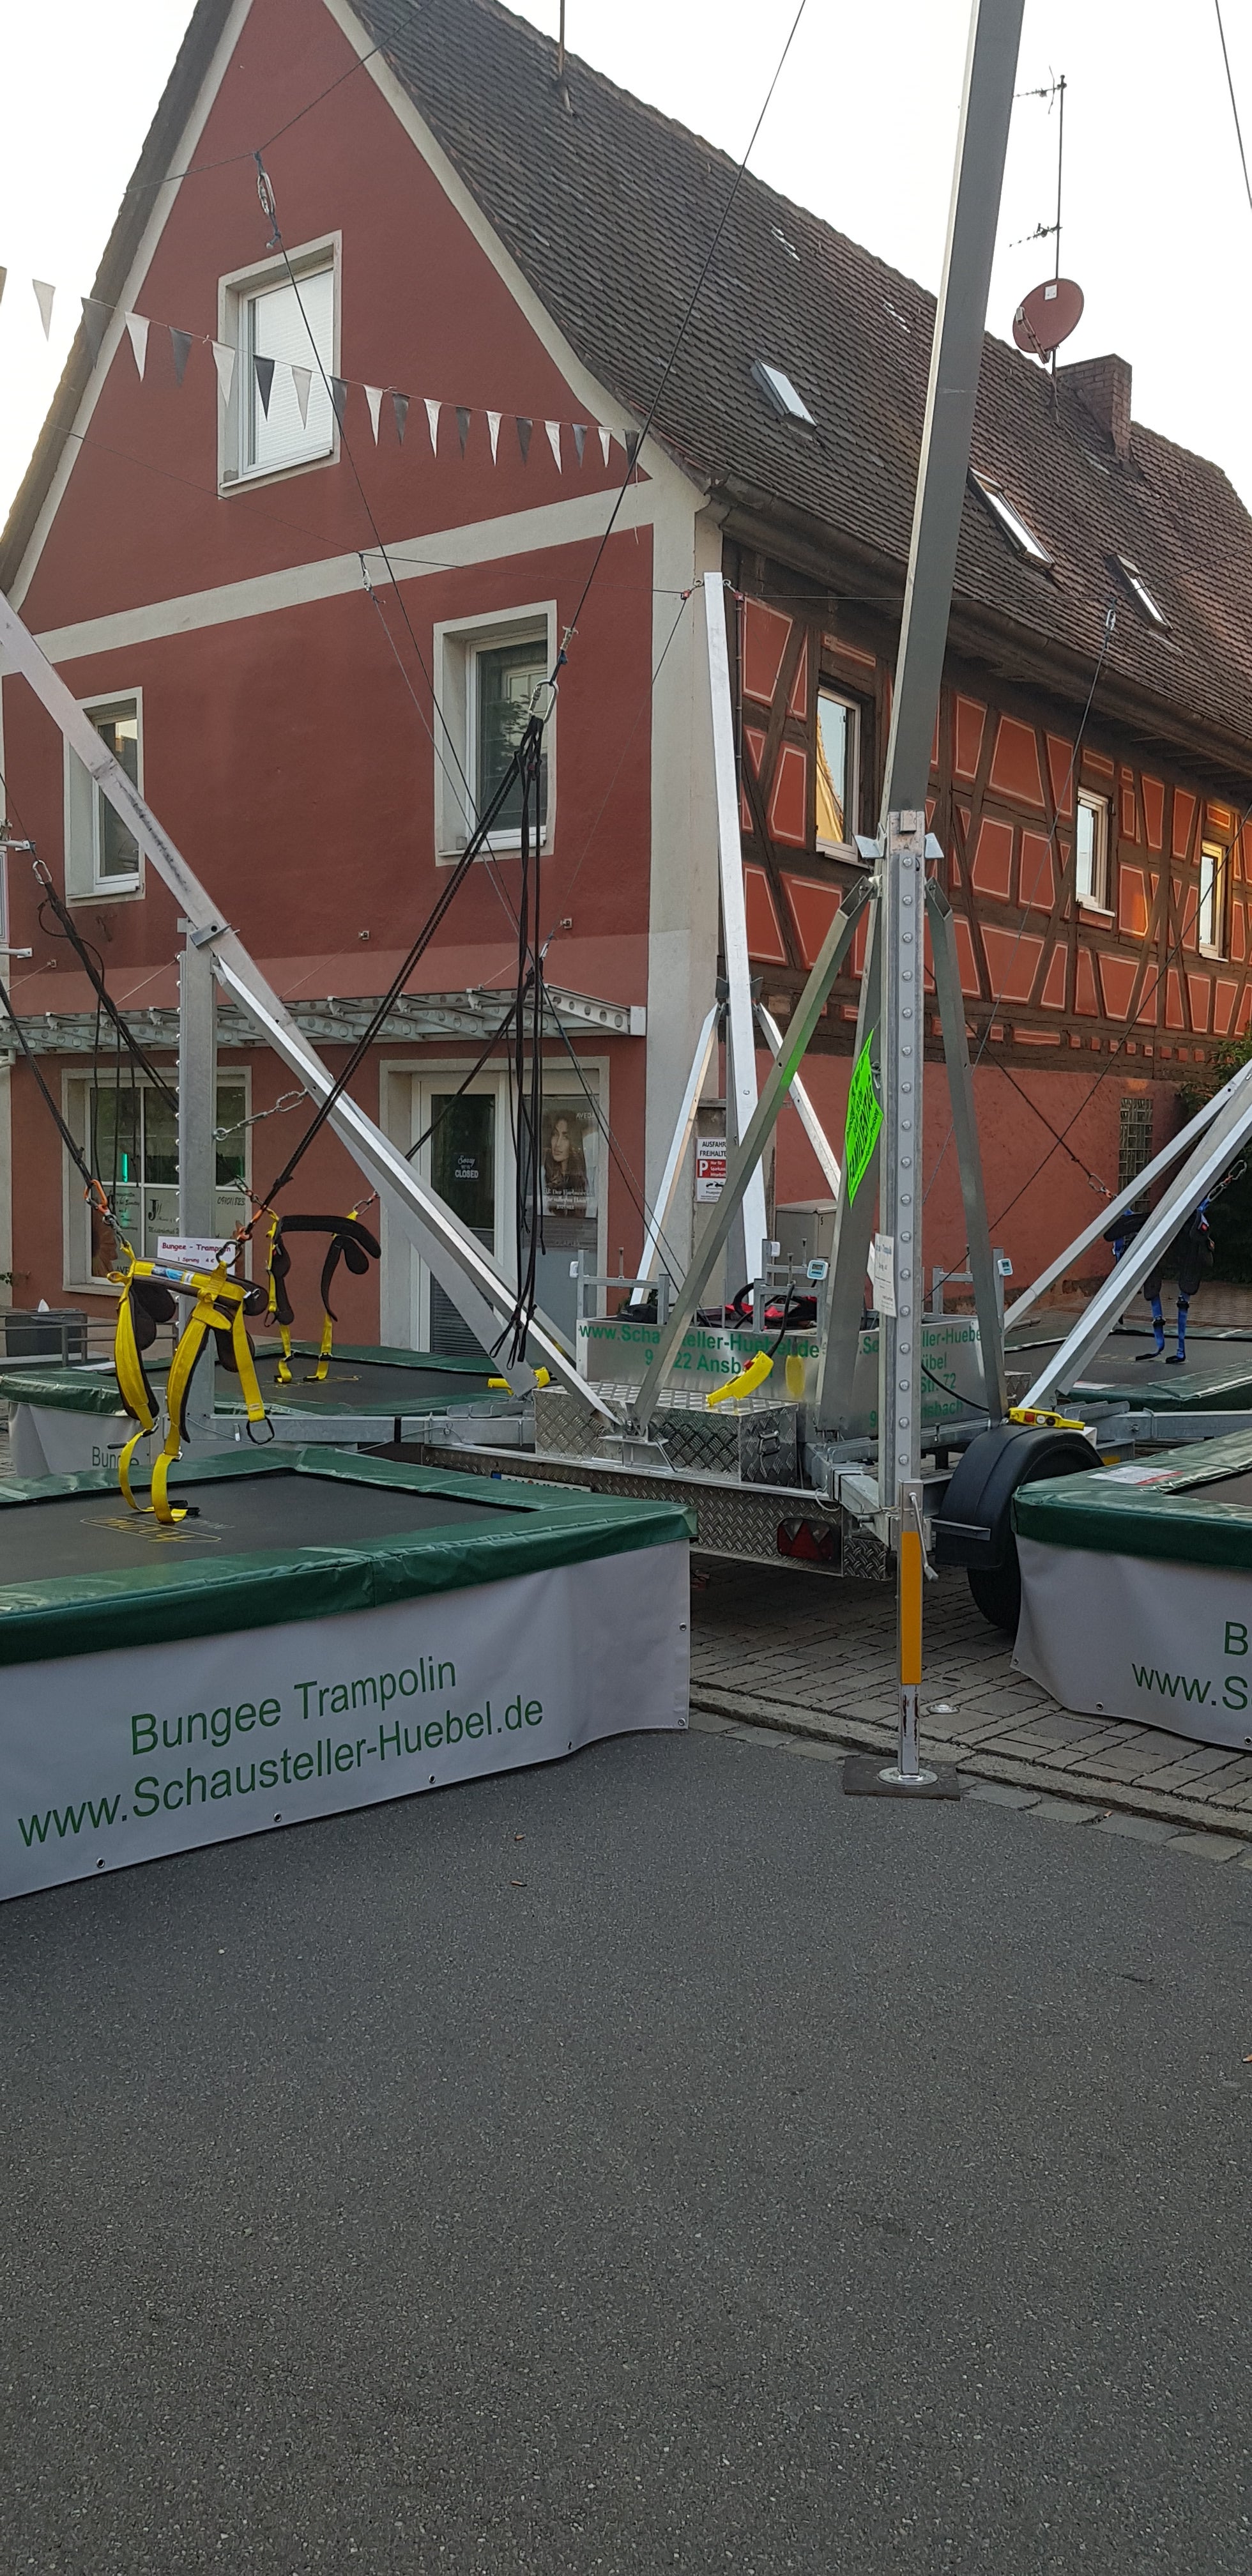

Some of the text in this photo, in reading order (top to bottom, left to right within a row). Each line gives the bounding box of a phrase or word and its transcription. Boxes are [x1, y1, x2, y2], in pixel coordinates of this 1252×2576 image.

[455, 1169, 479, 1179] CLOSED
[162, 1242, 187, 1252] Bungee
[131, 1655, 458, 1756] Bungee Trampolin
[1131, 1663, 1252, 1710] www.S
[17, 1694, 545, 1848] www.Schausteller-Huebel.de
